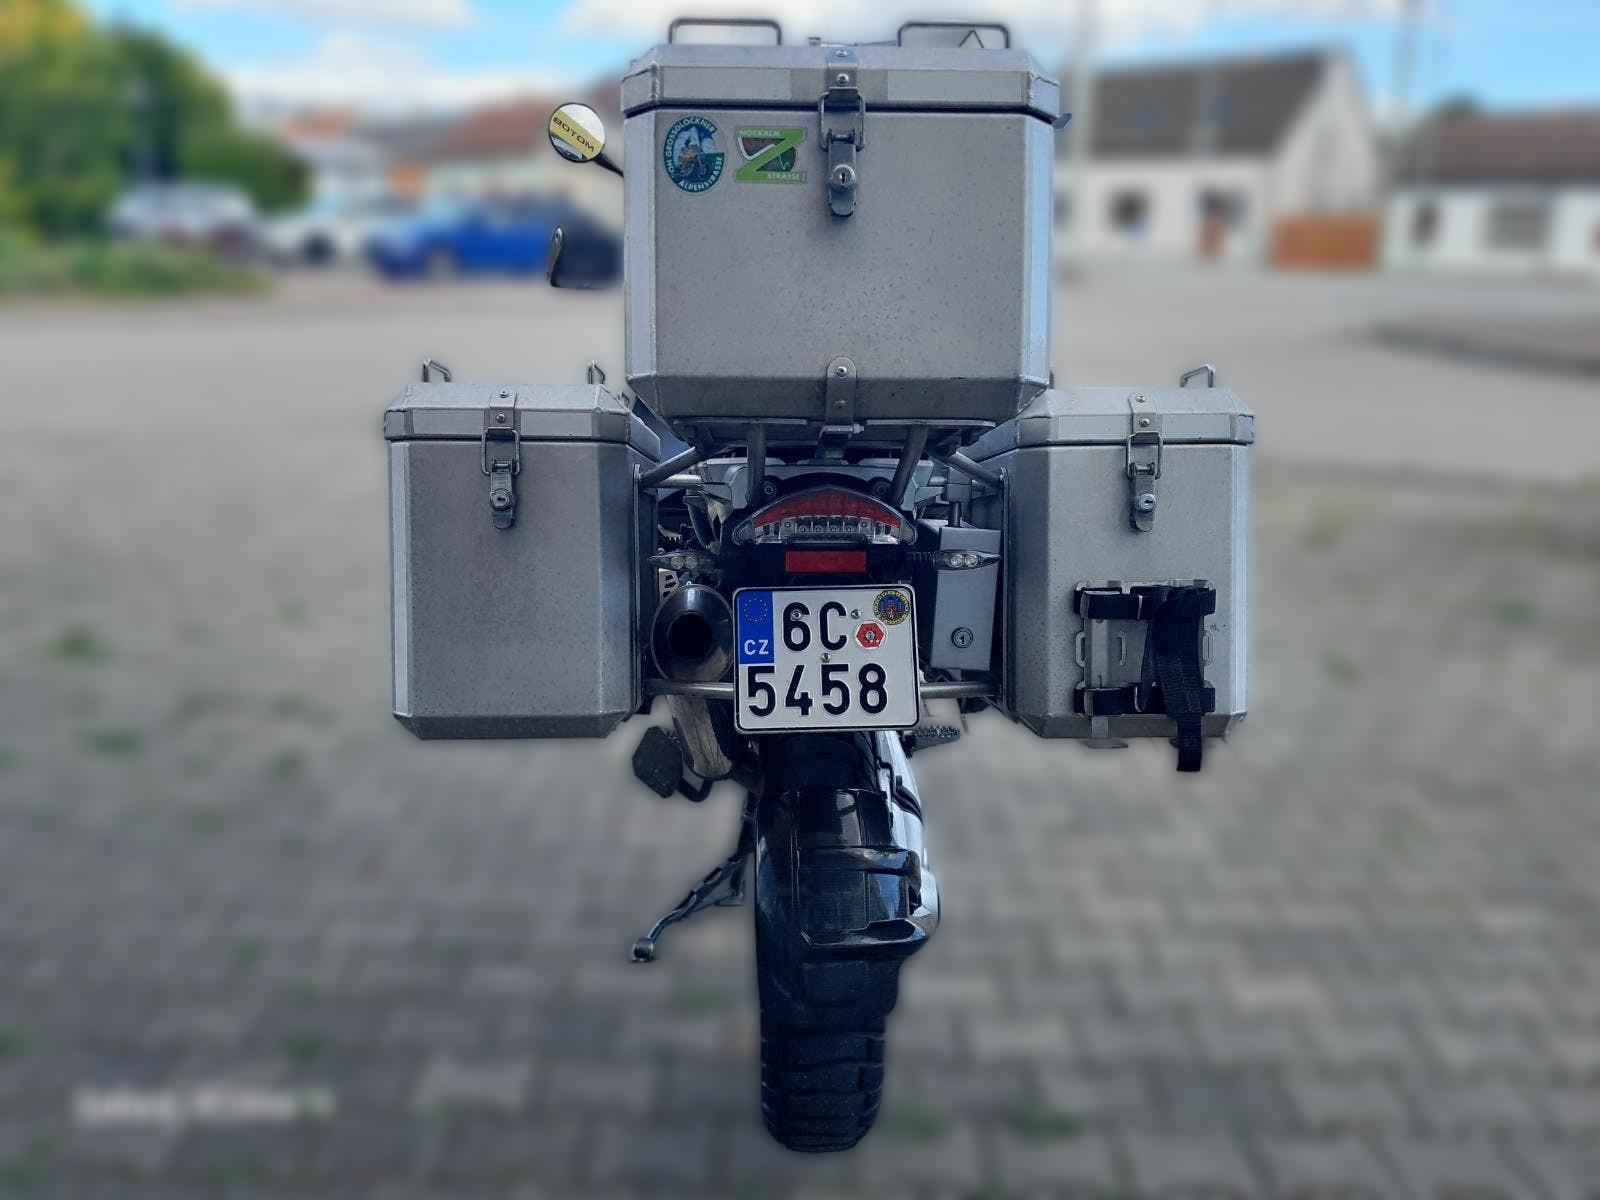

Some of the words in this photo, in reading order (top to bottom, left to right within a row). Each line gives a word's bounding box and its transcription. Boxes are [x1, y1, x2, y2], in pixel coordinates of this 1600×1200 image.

[744, 639, 769, 655] CZ
[783, 601, 848, 652] 6C
[747, 662, 888, 717] 5458
